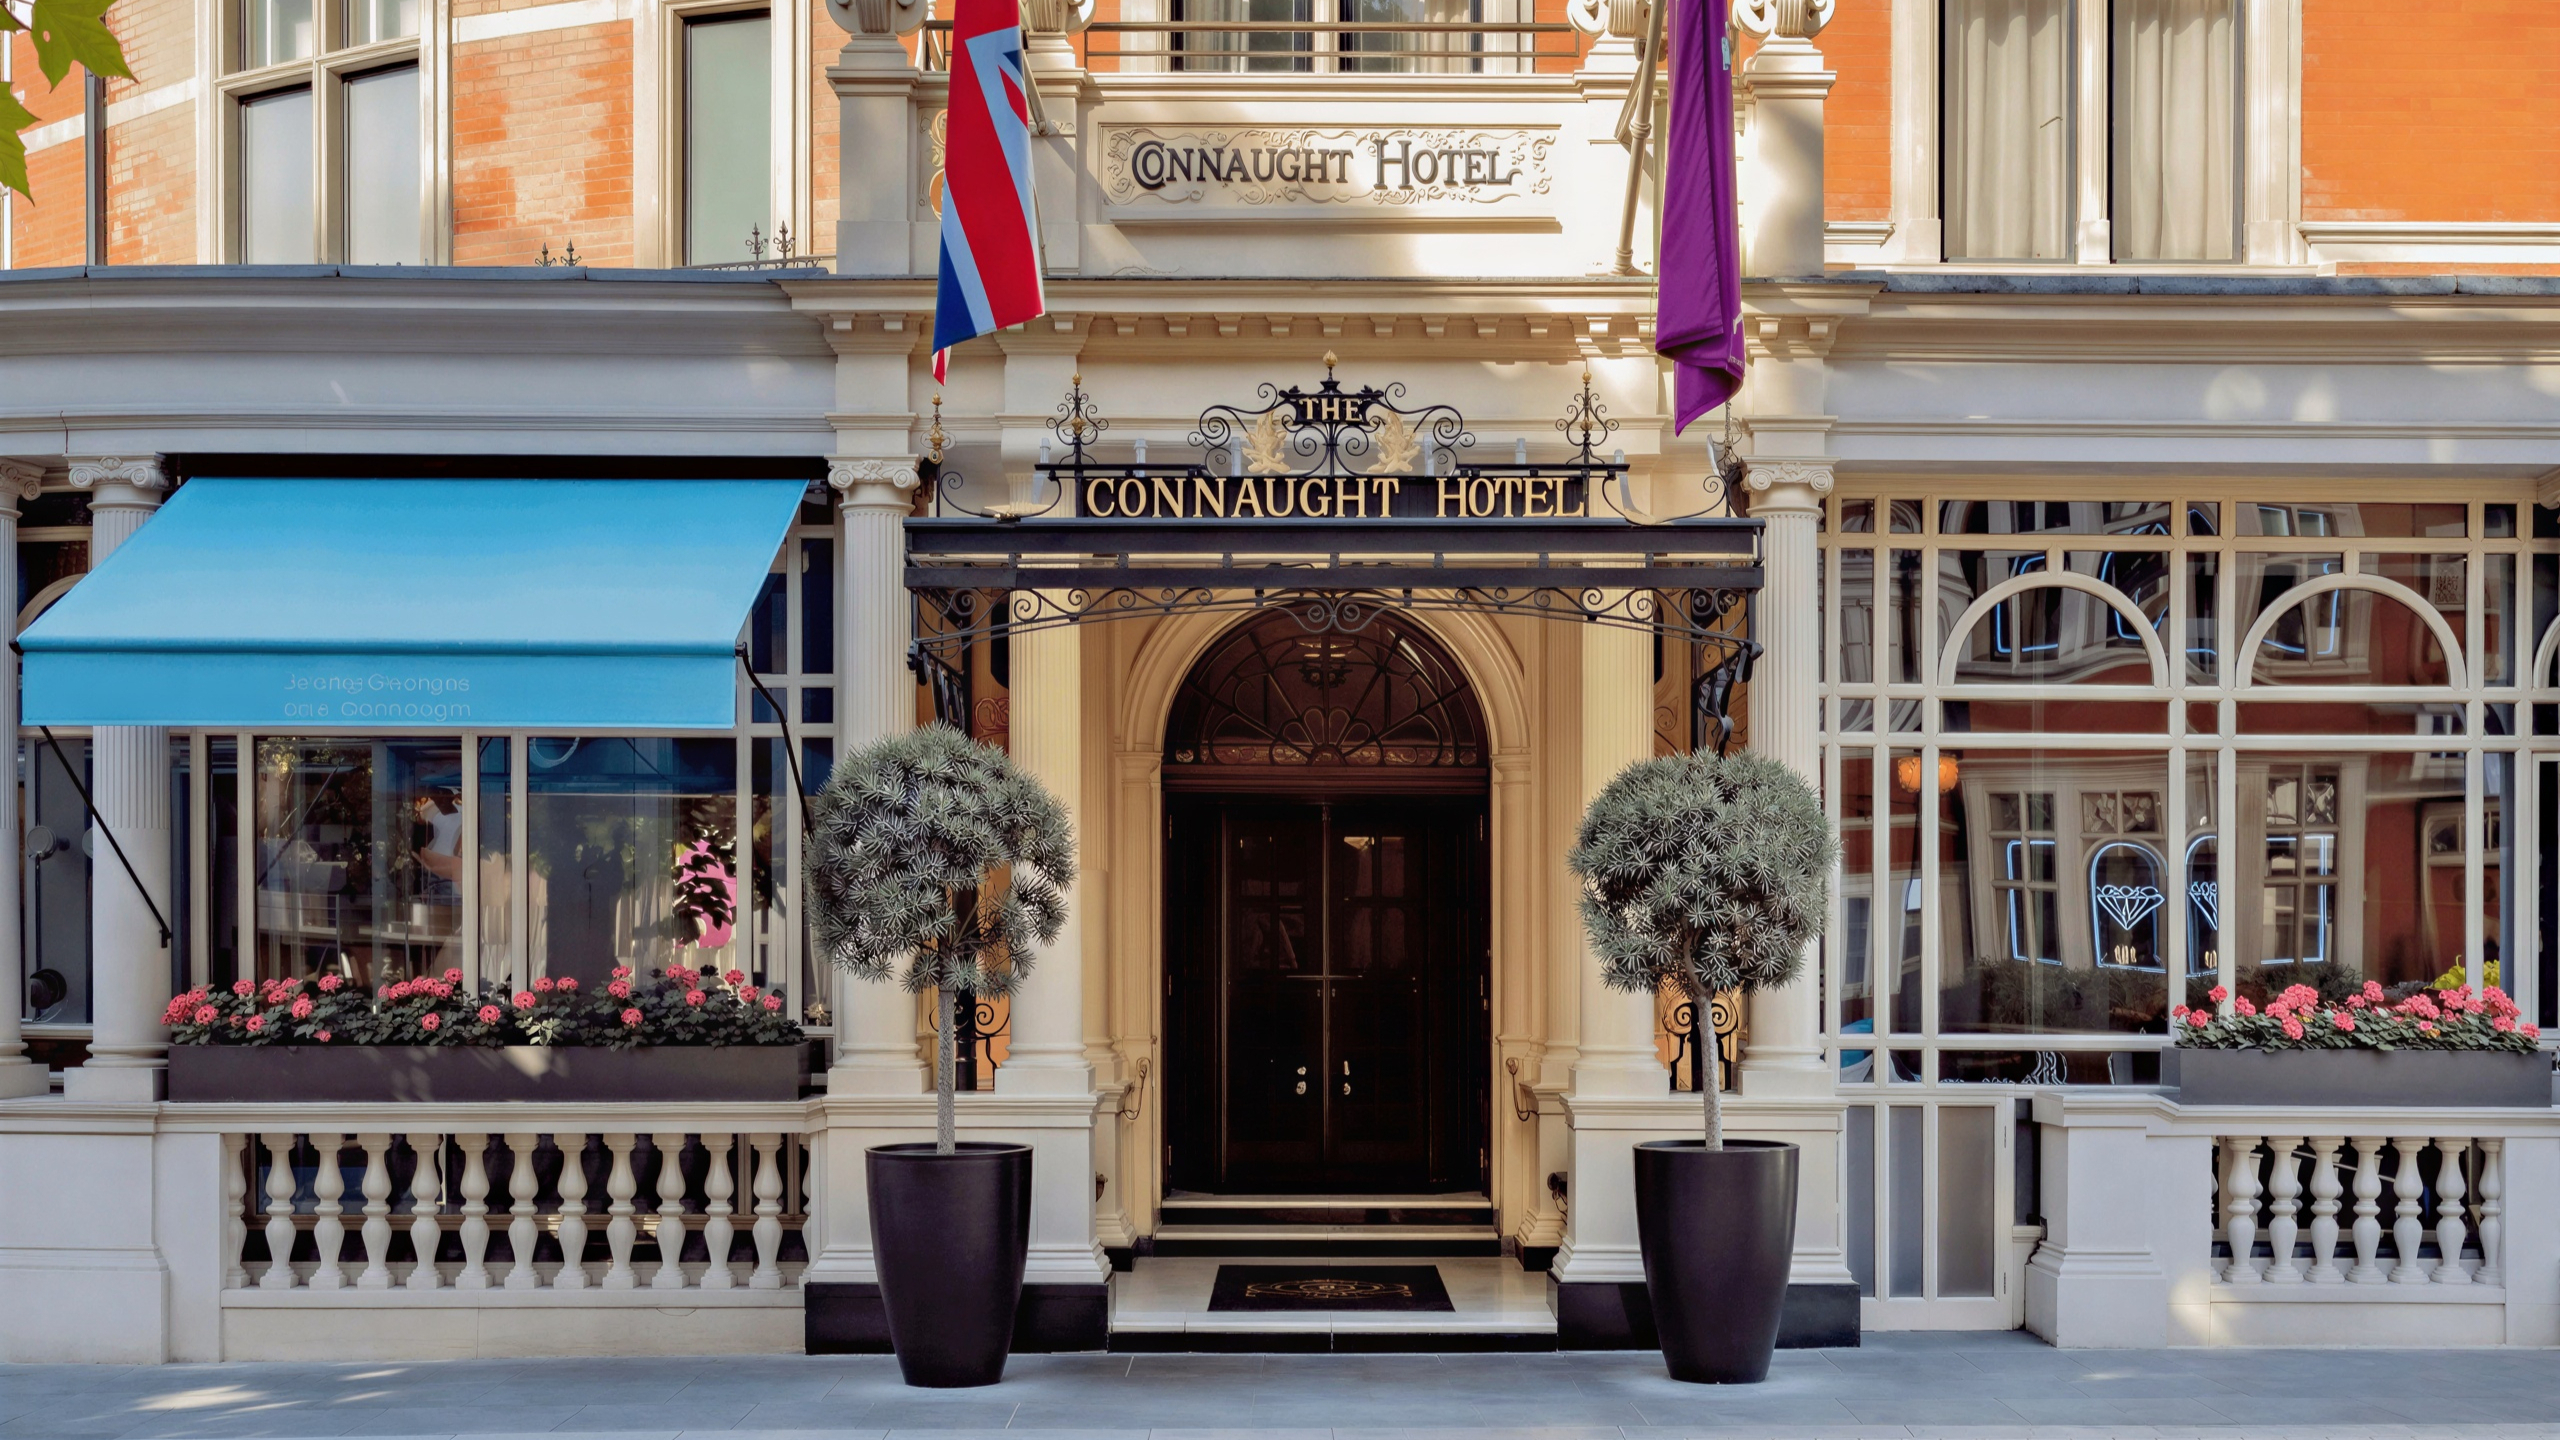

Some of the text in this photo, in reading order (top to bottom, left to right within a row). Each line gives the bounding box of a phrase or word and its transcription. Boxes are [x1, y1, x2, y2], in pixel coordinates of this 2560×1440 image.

[1131, 139, 1523, 190] CONNAUGHT HOTEL
[1301, 398, 1363, 421] THE
[1086, 477, 1585, 518] CONNAUGHT HOTEL
